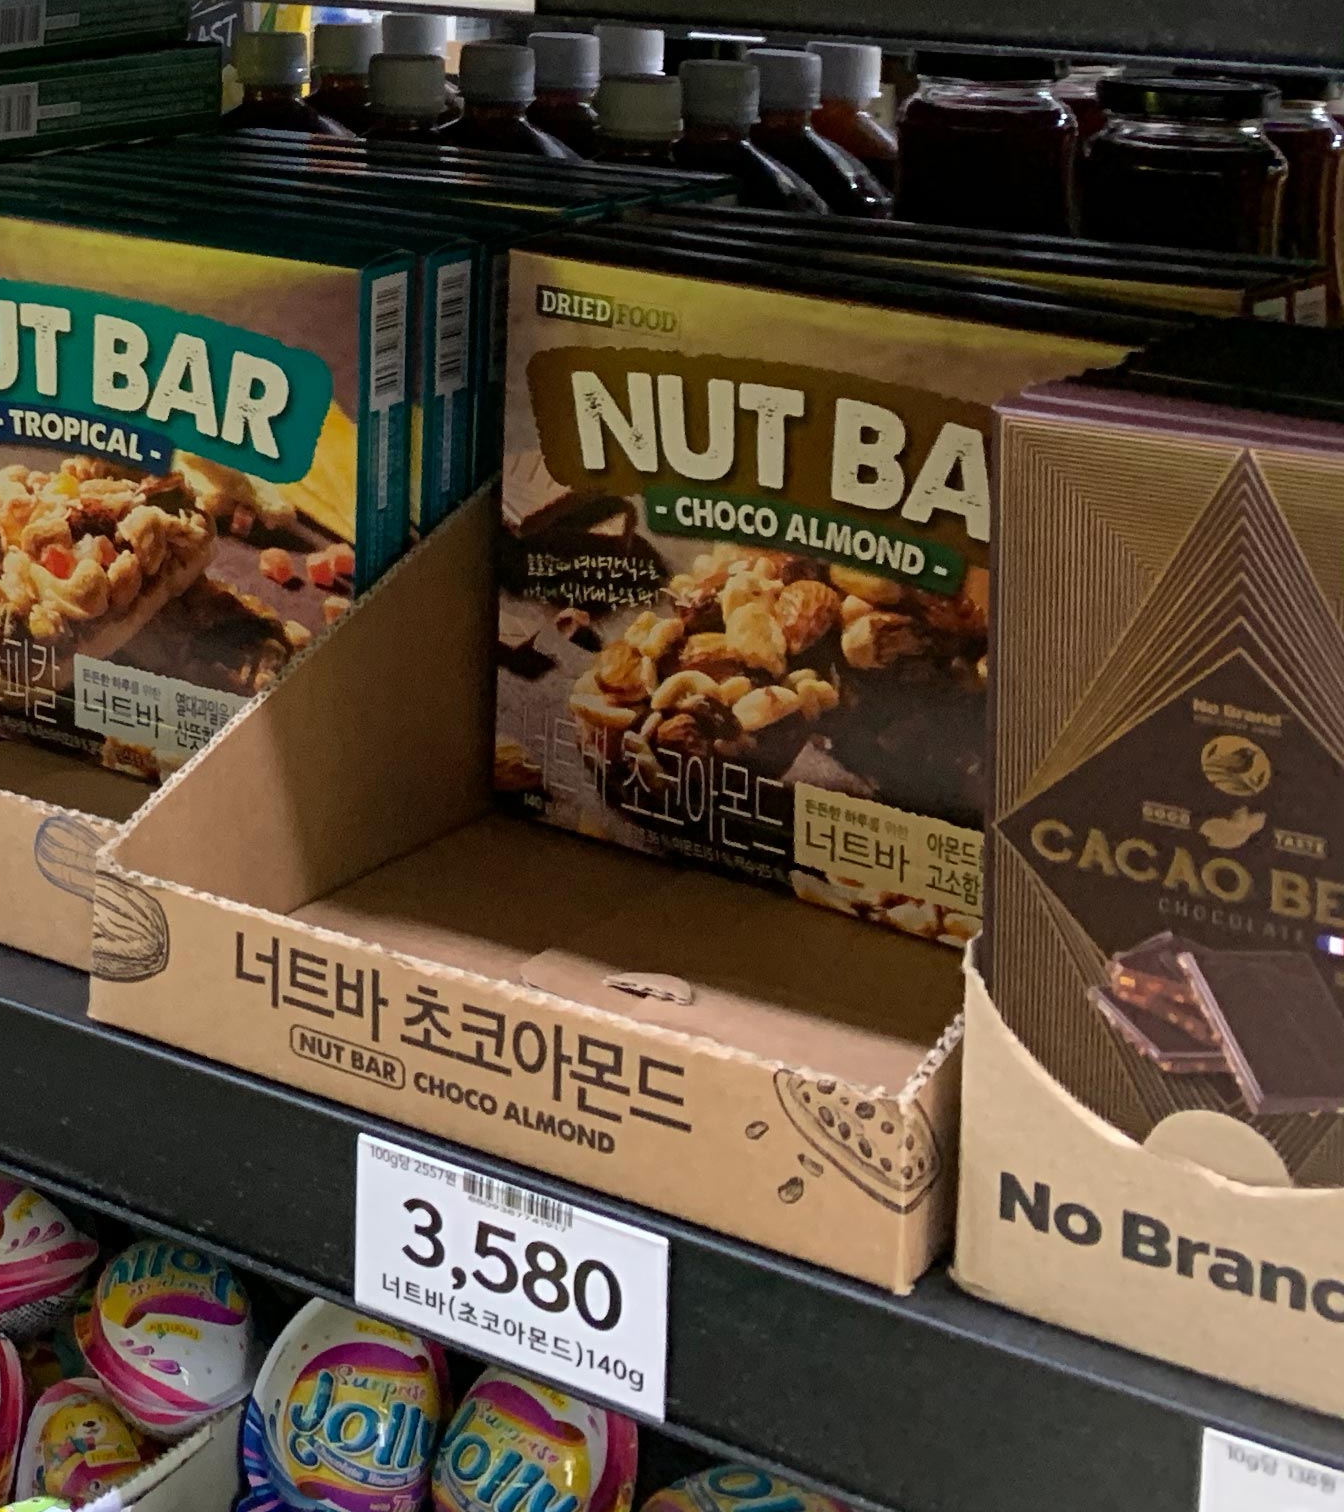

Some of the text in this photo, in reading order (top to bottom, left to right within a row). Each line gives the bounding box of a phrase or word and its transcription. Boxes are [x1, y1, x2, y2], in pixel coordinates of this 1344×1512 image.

[539, 287, 679, 335] DRIED FOOD
[92, 313, 290, 461] BAR
[9, 410, 144, 462] TROPICAL
[569, 369, 805, 491] NUT
[674, 496, 927, 579] CHOCO ALMOND
[82, 689, 165, 740] 너트바
[1192, 698, 1219, 716] No
[805, 820, 910, 883] 너트바
[1030, 818, 1253, 903] CACAO
[235, 928, 693, 1136] 너트바 초코아몬드
[299, 1033, 615, 1156] NUT BAR CHOCO ALMOND
[997, 1171, 1104, 1248] No
[401, 1197, 622, 1332] 3,580
[381, 1273, 645, 1392] 너트바(초코아몬드)140g
